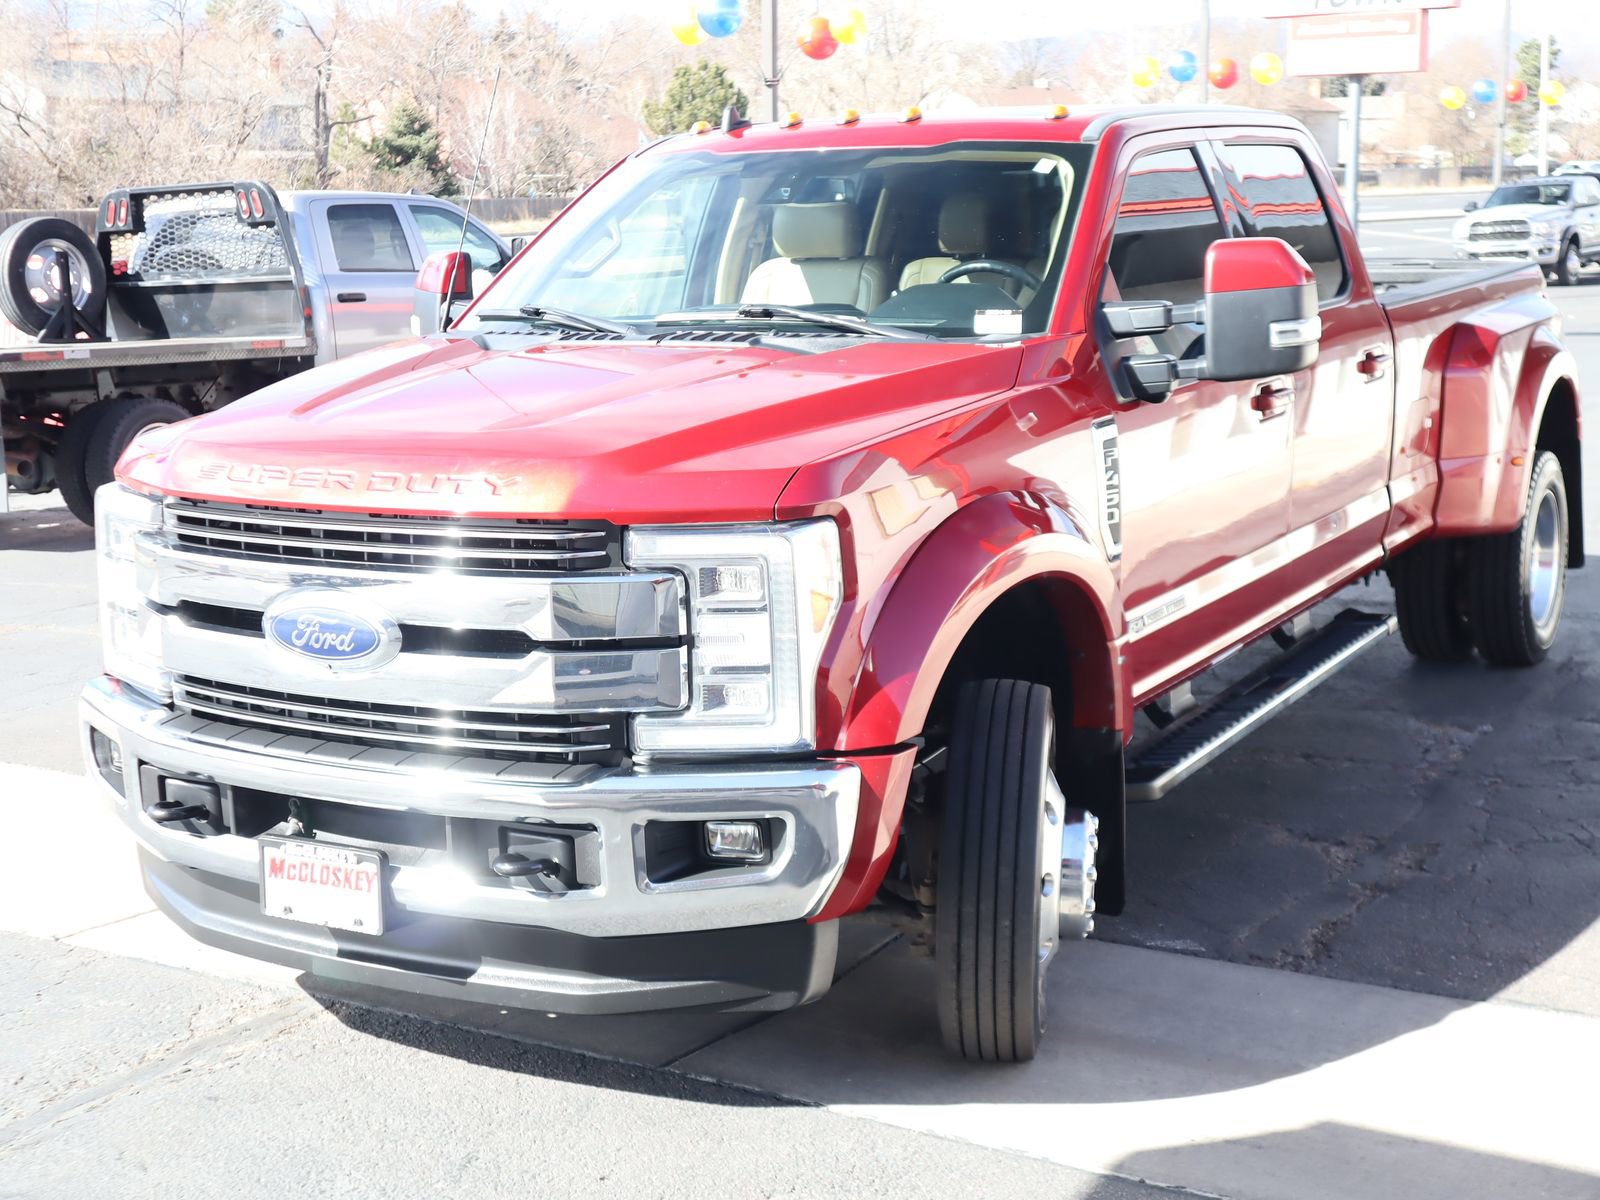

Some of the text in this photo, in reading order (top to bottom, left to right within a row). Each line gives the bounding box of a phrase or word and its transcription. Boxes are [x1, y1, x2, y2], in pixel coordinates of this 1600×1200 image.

[197, 462, 523, 497] SUPER DUTY
[291, 614, 355, 652] Ford
[268, 856, 378, 893] McCLOSKEY
